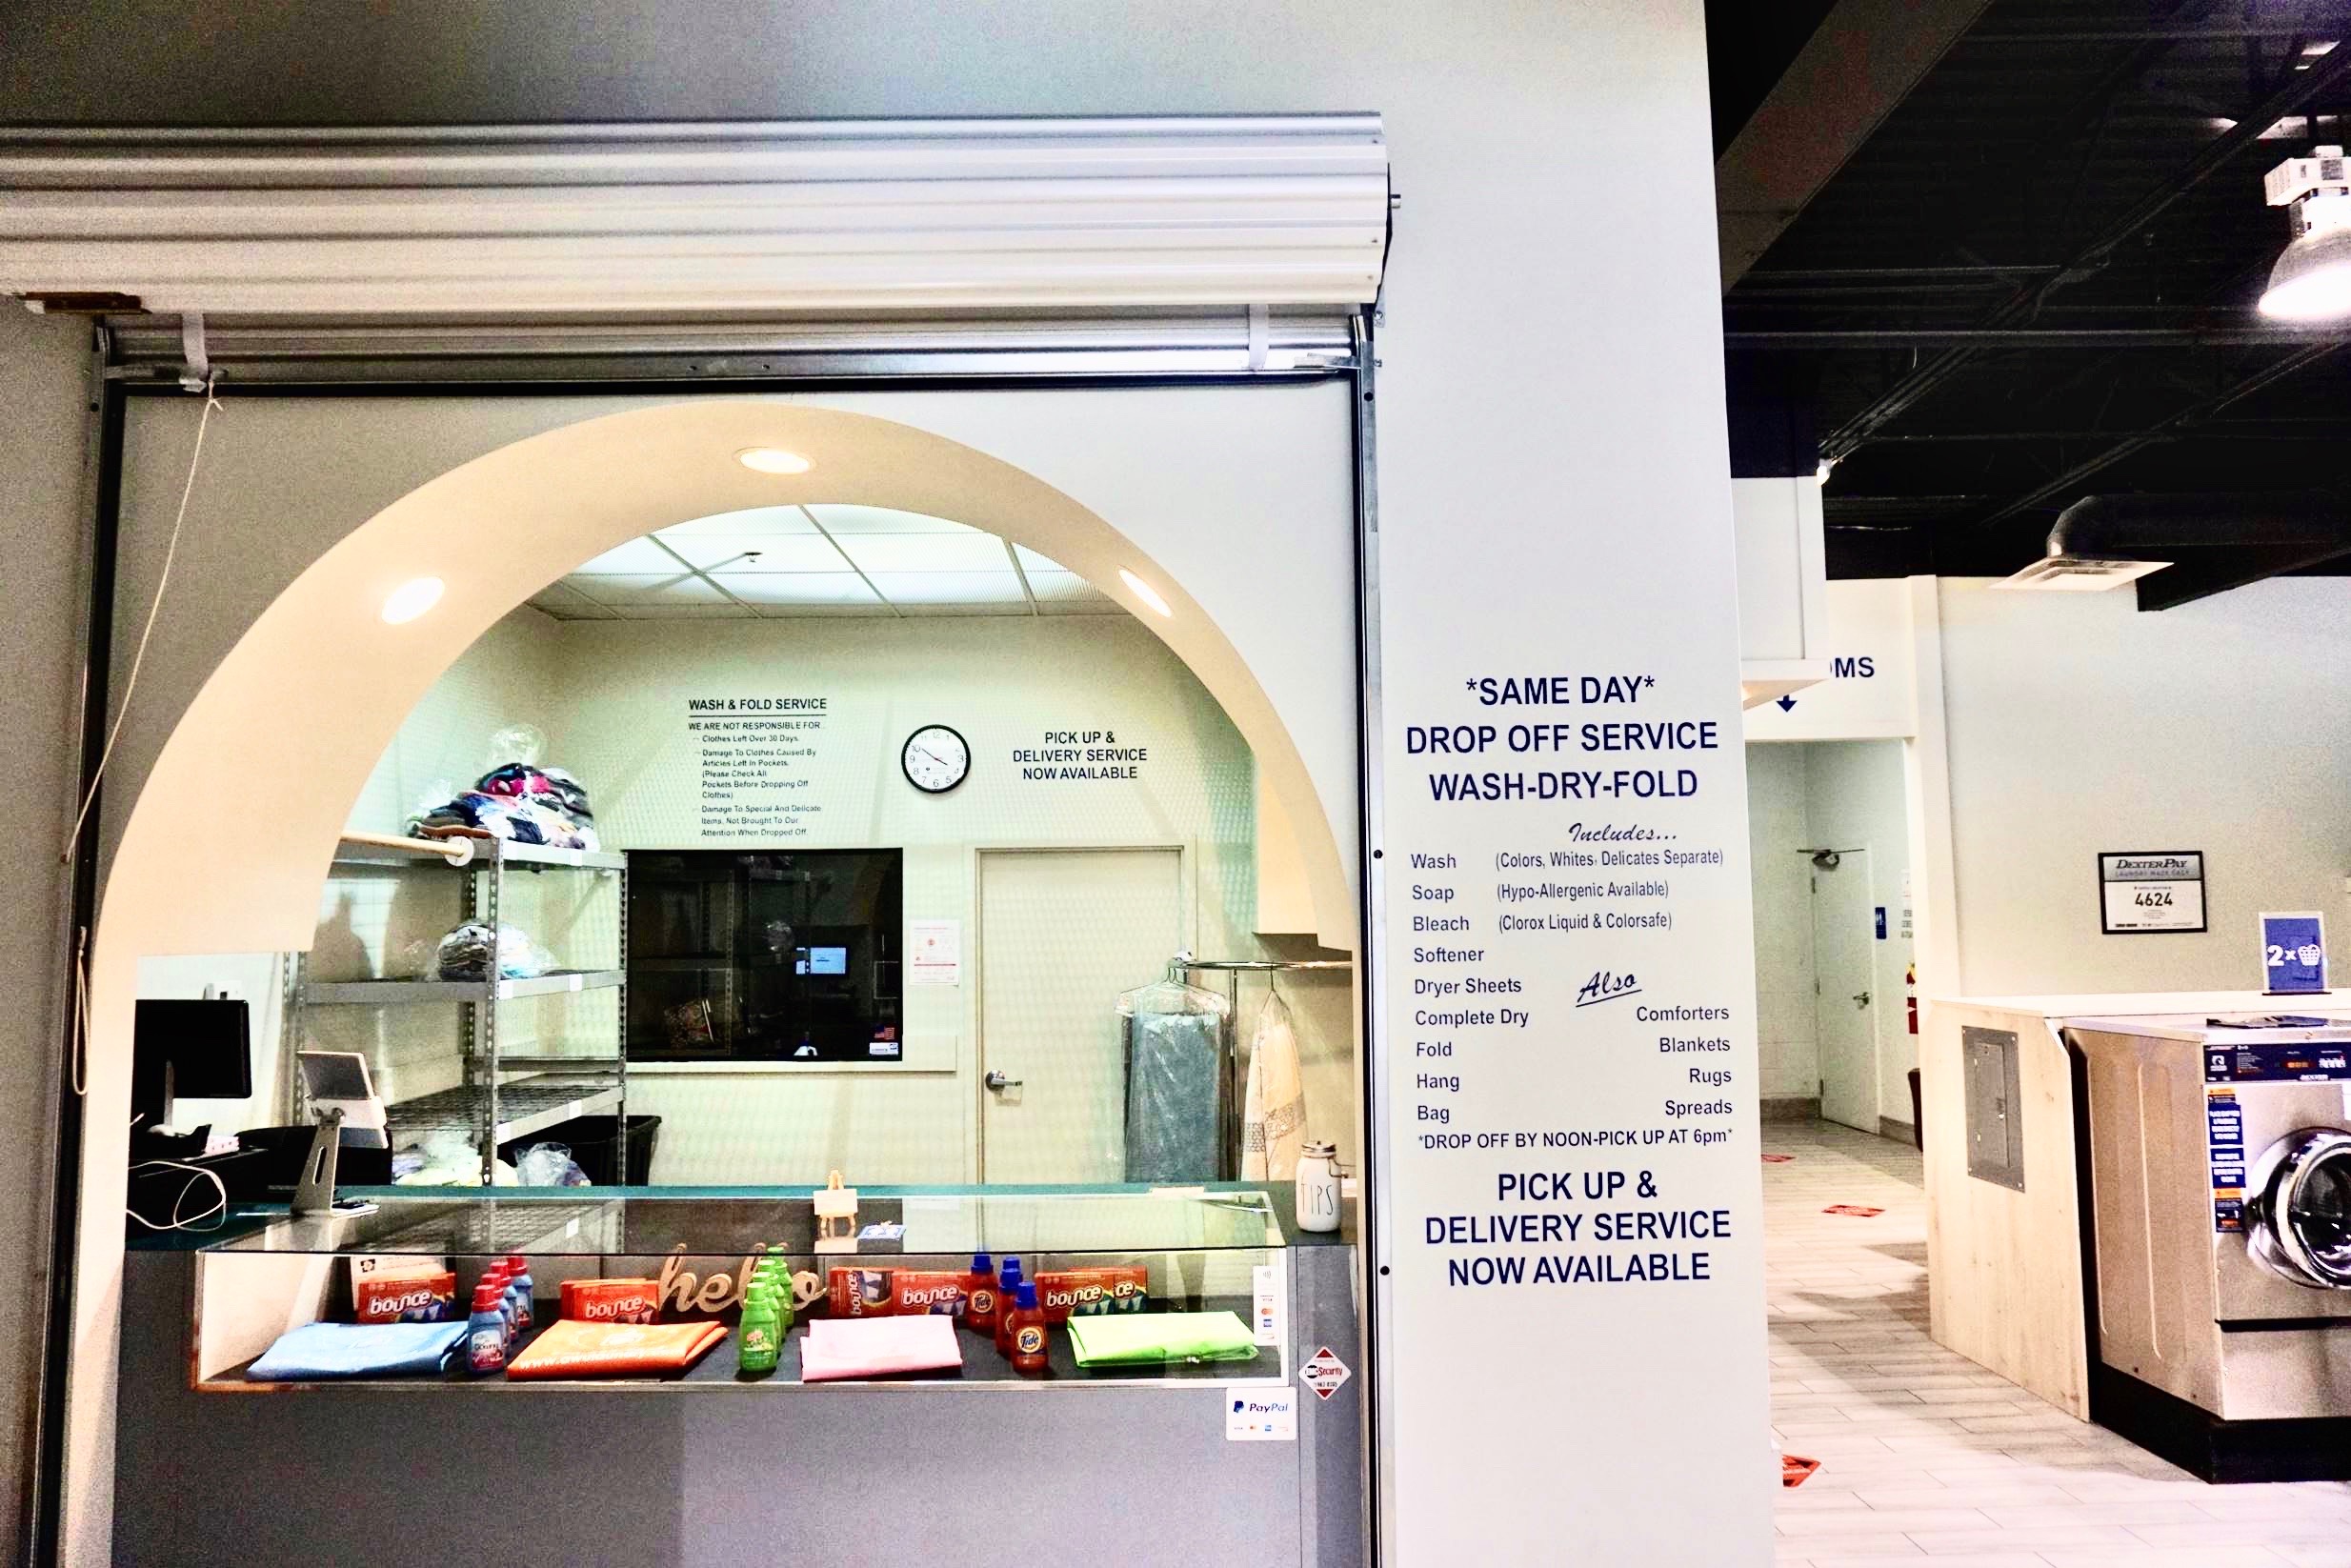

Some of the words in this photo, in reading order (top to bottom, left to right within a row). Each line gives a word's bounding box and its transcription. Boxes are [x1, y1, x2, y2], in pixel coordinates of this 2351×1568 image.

[689, 699, 724, 710] WASH
[729, 700, 735, 710] &
[740, 699, 772, 710] FOLD
[776, 698, 826, 709] SERVICE
[1046, 732, 1077, 744] PICK
[1083, 732, 1100, 743] UP
[1106, 732, 1115, 743] &
[1408, 726, 1496, 754] DROP
[1509, 725, 1569, 752] OFF
[1581, 722, 1718, 751] SERVICE
[1014, 750, 1081, 762] DELIVERY
[1087, 749, 1147, 761] SERVICE
[1024, 768, 1056, 779] NOW
[1060, 767, 1136, 779] AVAILABLE
[761, 780, 794, 789] Dropping
[1429, 770, 1697, 800] WASH-DRY-FOLD
[1411, 854, 1456, 869] Wash
[1497, 853, 1544, 871] (Colors,
[1602, 851, 1658, 865] Delicates
[1664, 850, 1722, 868] Separate)
[1413, 885, 1454, 903] Soap
[1497, 883, 1603, 902] (Hypo-Allergenic
[1608, 881, 1668, 898] Available)
[2135, 893, 2173, 906] 4624
[1414, 916, 1469, 931] Bleach
[1499, 915, 1544, 934] (Clorox
[1550, 915, 1588, 933] Liquid
[1594, 914, 1601, 928] &
[1607, 913, 1671, 929] Colorsafe)
[1415, 948, 1484, 962] Softener
[1416, 979, 1460, 997] Dryer
[1466, 978, 1521, 993] Sheets
[1577, 972, 1637, 1002] Also
[1416, 1010, 1494, 1028] Complete
[1501, 1009, 1528, 1027] Dry
[1638, 1006, 1729, 1021] Comforters
[1417, 1042, 1451, 1056] Fold
[1660, 1037, 1730, 1052] Blankets
[1417, 1074, 1458, 1092] Hang
[1690, 1069, 1731, 1086] Rugs
[1418, 1106, 1449, 1124] Bag
[1666, 1099, 1732, 1118] Spreads
[1477, 1134, 1509, 1148] OFF
[1516, 1133, 1537, 1147] BY
[1543, 1131, 1638, 1146] NOON-PICK
[1643, 1130, 1664, 1144] UP
[1669, 1130, 1688, 1143] AT
[1499, 1173, 1573, 1200] PICK
[1584, 1172, 1625, 1199] UP
[1638, 1171, 1658, 1197] &
[1301, 1183, 1335, 1216] TIPS
[1426, 1215, 1582, 1243] DELIVERY
[1595, 1211, 1731, 1240] SERVICE
[1450, 1257, 1525, 1286] NOW
[1534, 1253, 1710, 1283] AVAILABLE
[370, 1291, 431, 1315] bounce
[903, 1284, 959, 1305] bounce
[975, 1294, 992, 1308] Tide
[1046, 1284, 1103, 1306] bounce
[585, 1297, 645, 1320] bounce
[1020, 1332, 1040, 1347] Tide
[1250, 1403, 1288, 1413] PayPal
